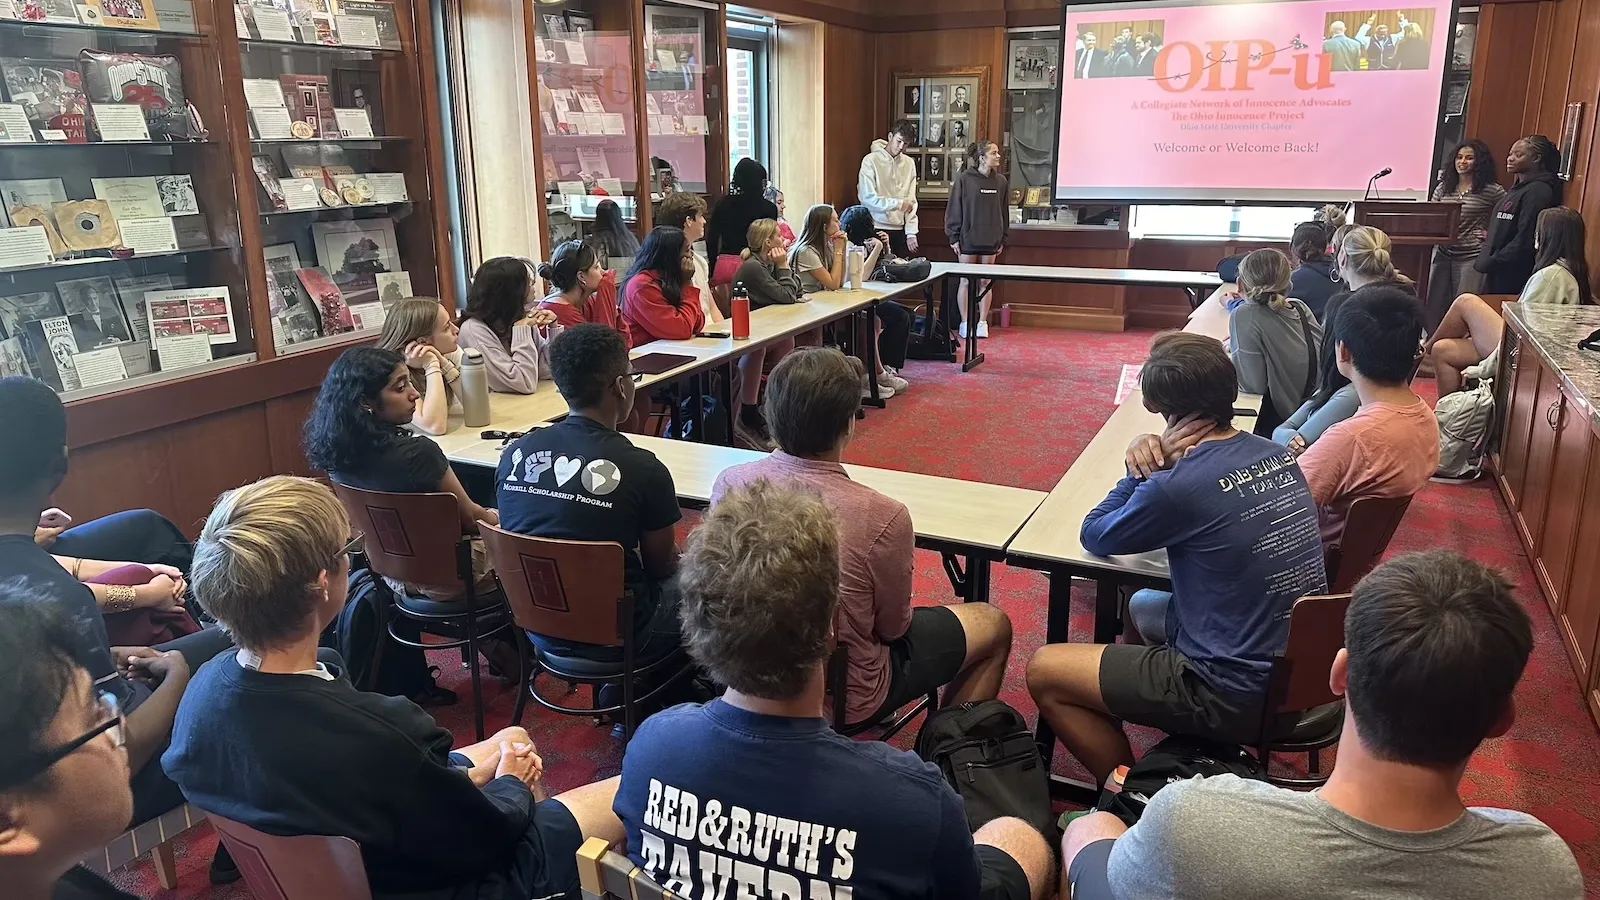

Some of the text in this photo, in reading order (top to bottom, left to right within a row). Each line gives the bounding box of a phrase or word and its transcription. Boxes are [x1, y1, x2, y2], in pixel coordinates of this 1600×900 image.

[1154, 39, 1335, 93] OIP-u
[1131, 98, 1352, 111] A Collegiate Network of Innocence Advocates
[1172, 110, 1305, 122] The Ohio Innocence Project
[1180, 122, 1292, 132] Ohio State University Chapter
[1153, 142, 1206, 153] Welcome
[1226, 142, 1280, 152] Welcome
[1284, 142, 1320, 152] Back!
[44, 320, 68, 328] ELTON
[50, 326, 70, 334] JOHN
[503, 482, 612, 508] MORRILL SCHOLARSHIP PROGRAM
